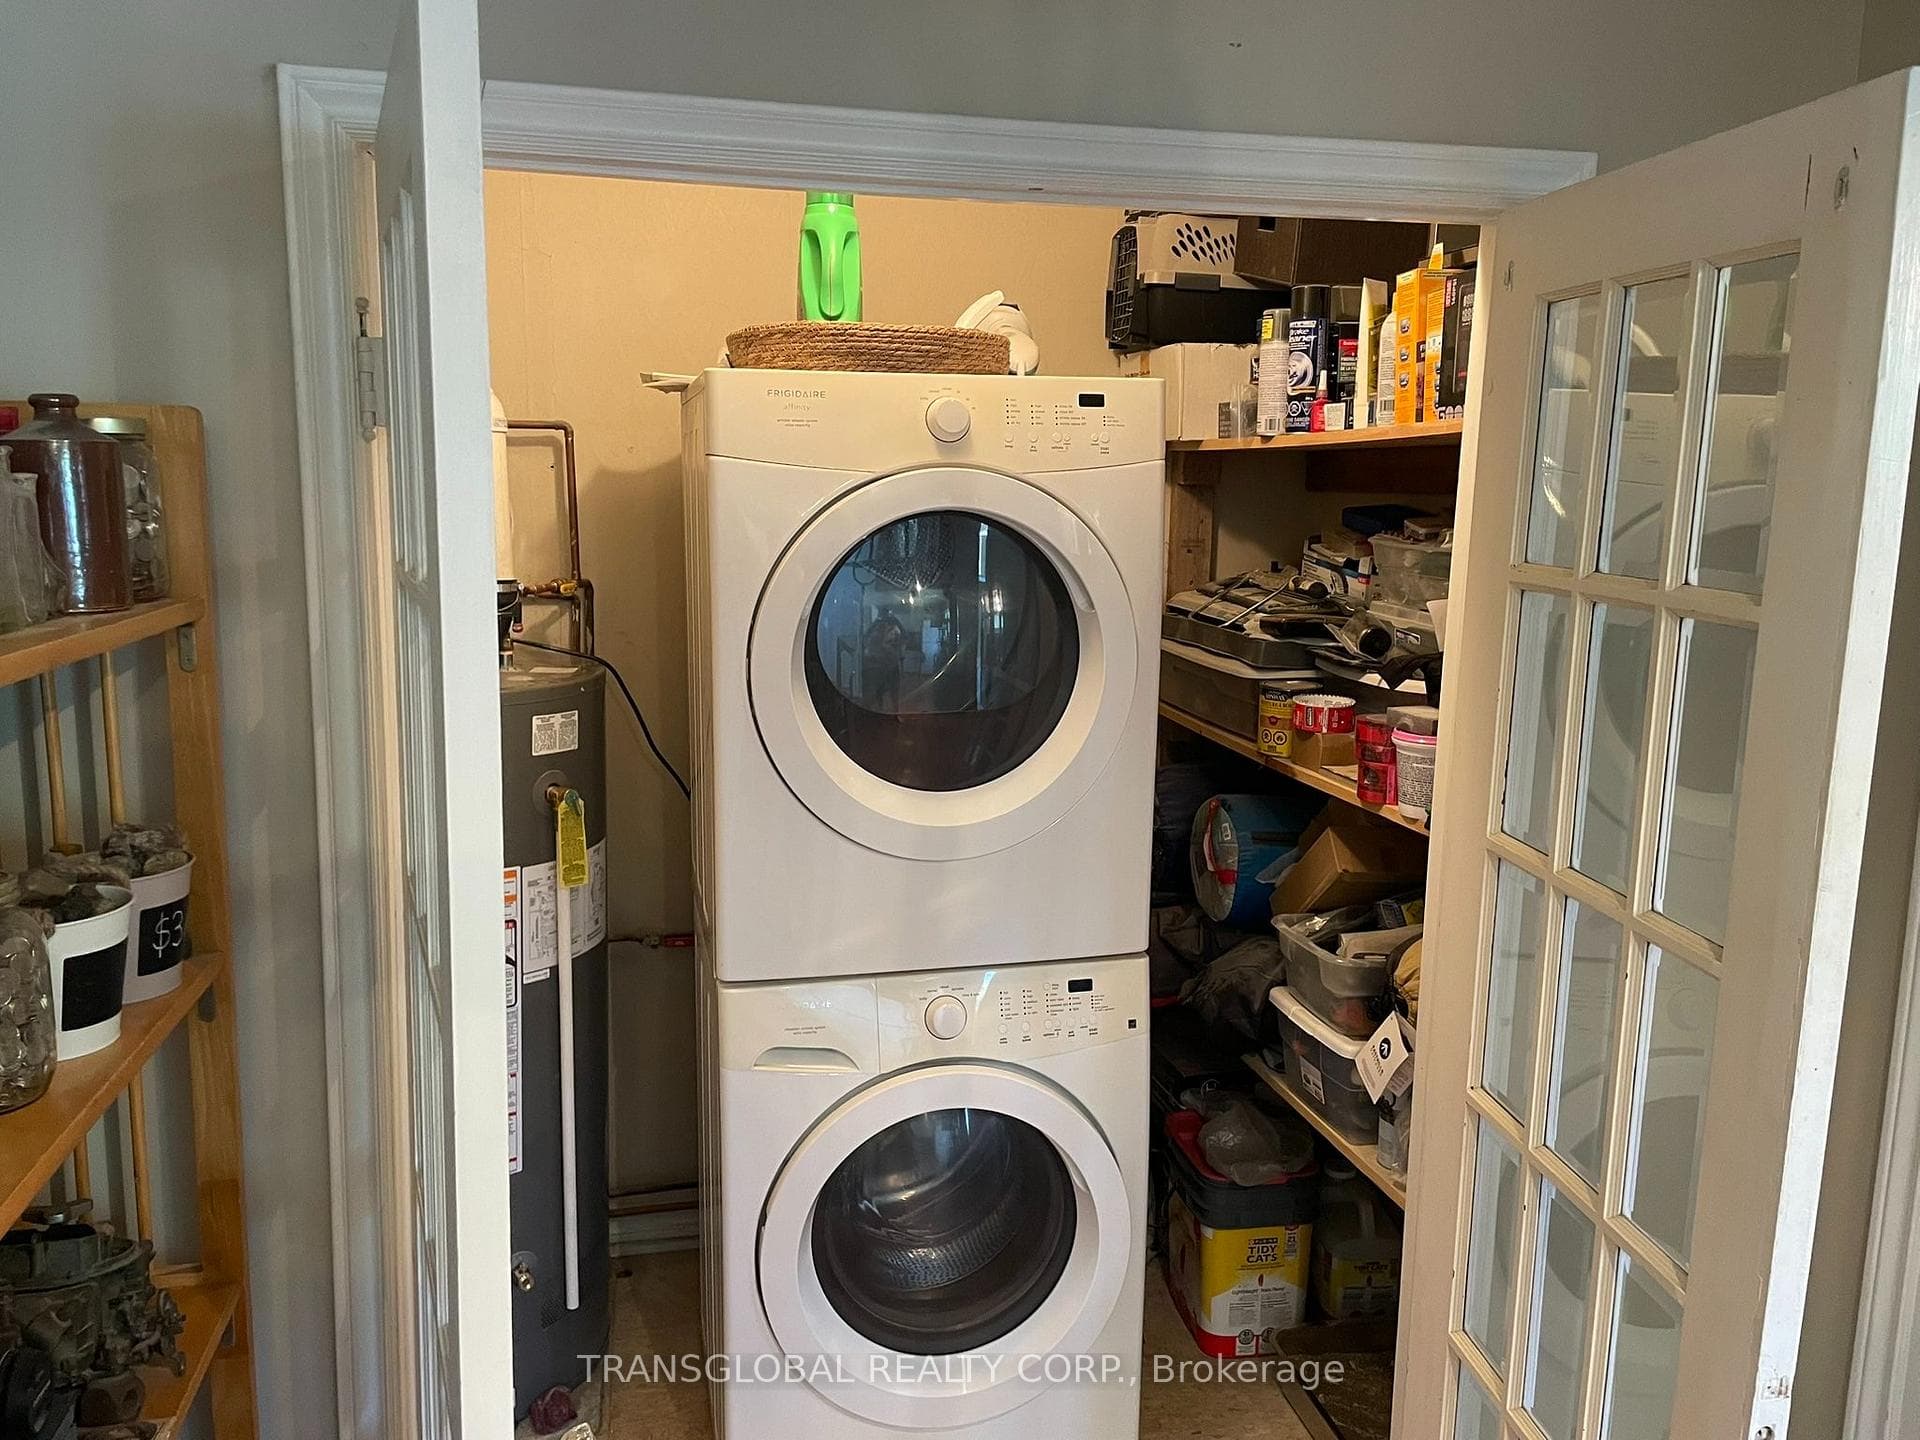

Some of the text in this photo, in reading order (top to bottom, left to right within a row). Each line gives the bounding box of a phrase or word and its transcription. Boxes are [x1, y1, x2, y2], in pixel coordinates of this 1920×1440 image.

[767, 389, 826, 399] FRIGIDAIRE
[152, 910, 184, 959] $3
[1248, 1245, 1277, 1255] TIDY
[1246, 1254, 1278, 1263] CATS
